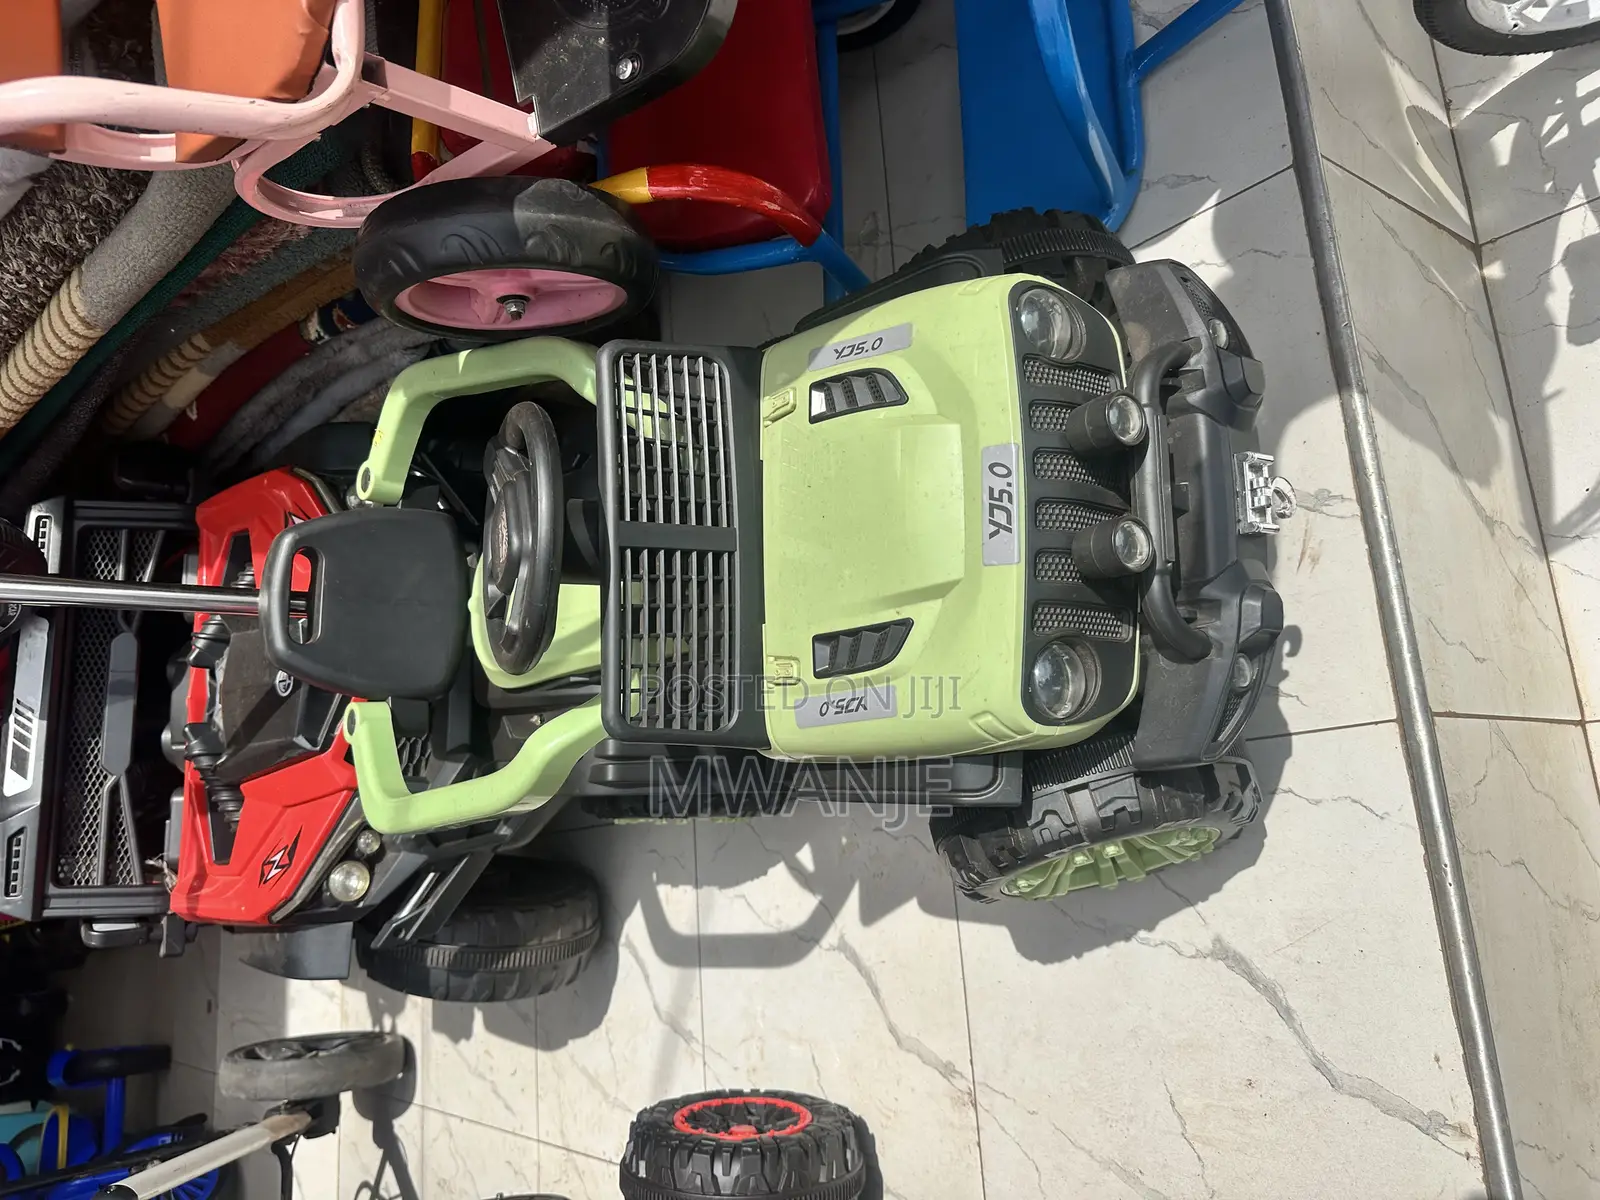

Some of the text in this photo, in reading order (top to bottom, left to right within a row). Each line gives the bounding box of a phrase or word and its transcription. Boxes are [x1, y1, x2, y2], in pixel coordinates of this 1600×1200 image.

[833, 336, 884, 360] YJ5.0
[988, 462, 1012, 540] YJ5.0
[819, 696, 868, 717] YJ5.0
